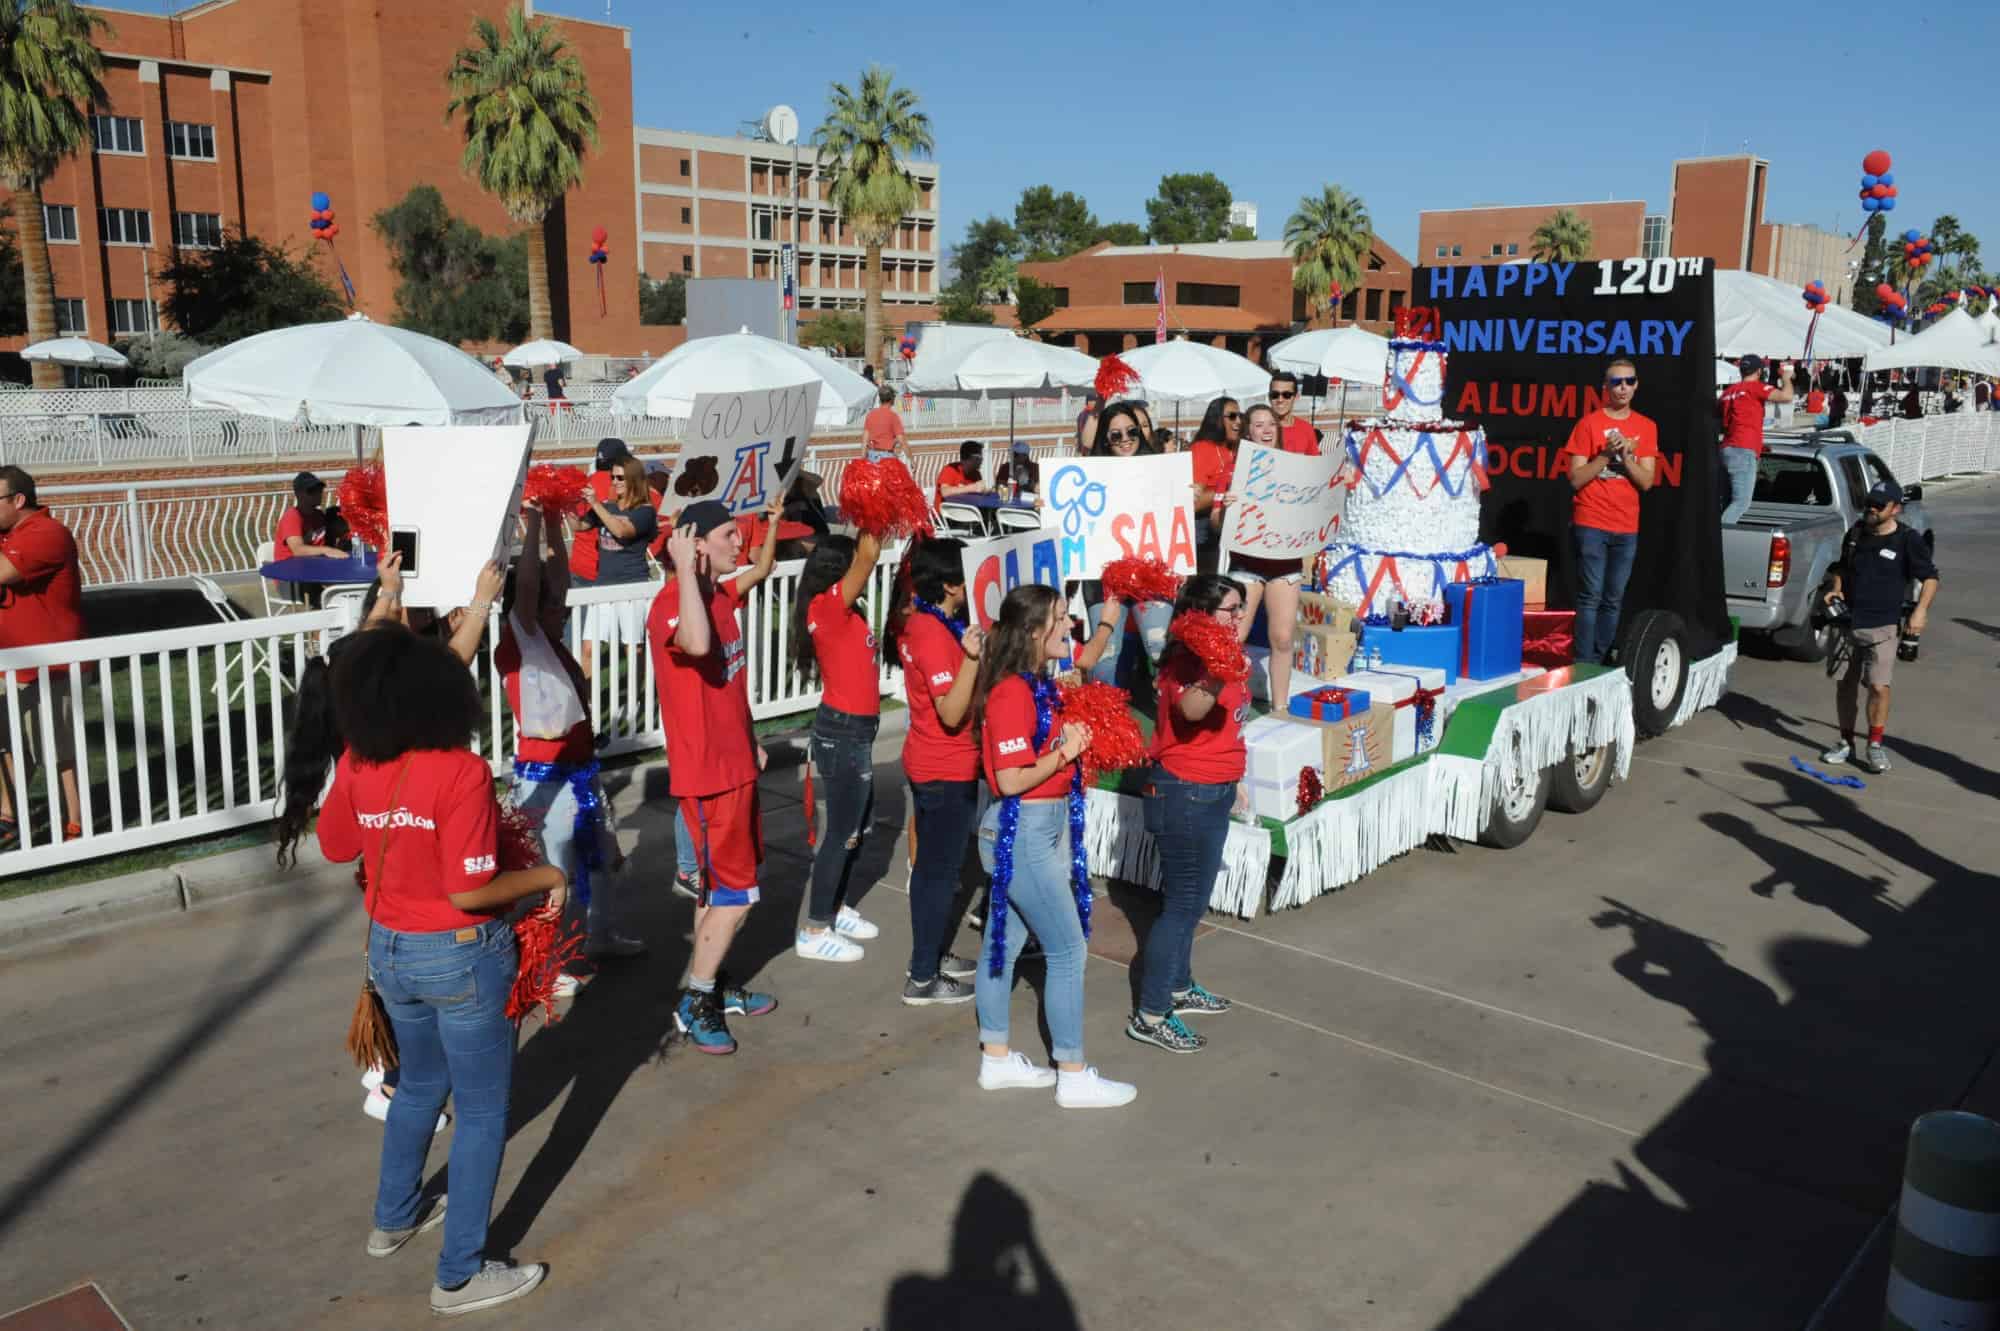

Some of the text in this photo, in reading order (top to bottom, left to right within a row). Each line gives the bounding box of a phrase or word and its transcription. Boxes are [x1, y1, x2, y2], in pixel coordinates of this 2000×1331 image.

[1429, 263, 1577, 299] HAPPY
[1423, 318, 1695, 356] NNIVERSARY
[701, 395, 743, 440] GO
[1455, 381, 1611, 418] ALUMN
[1111, 505, 1196, 570] SAA
